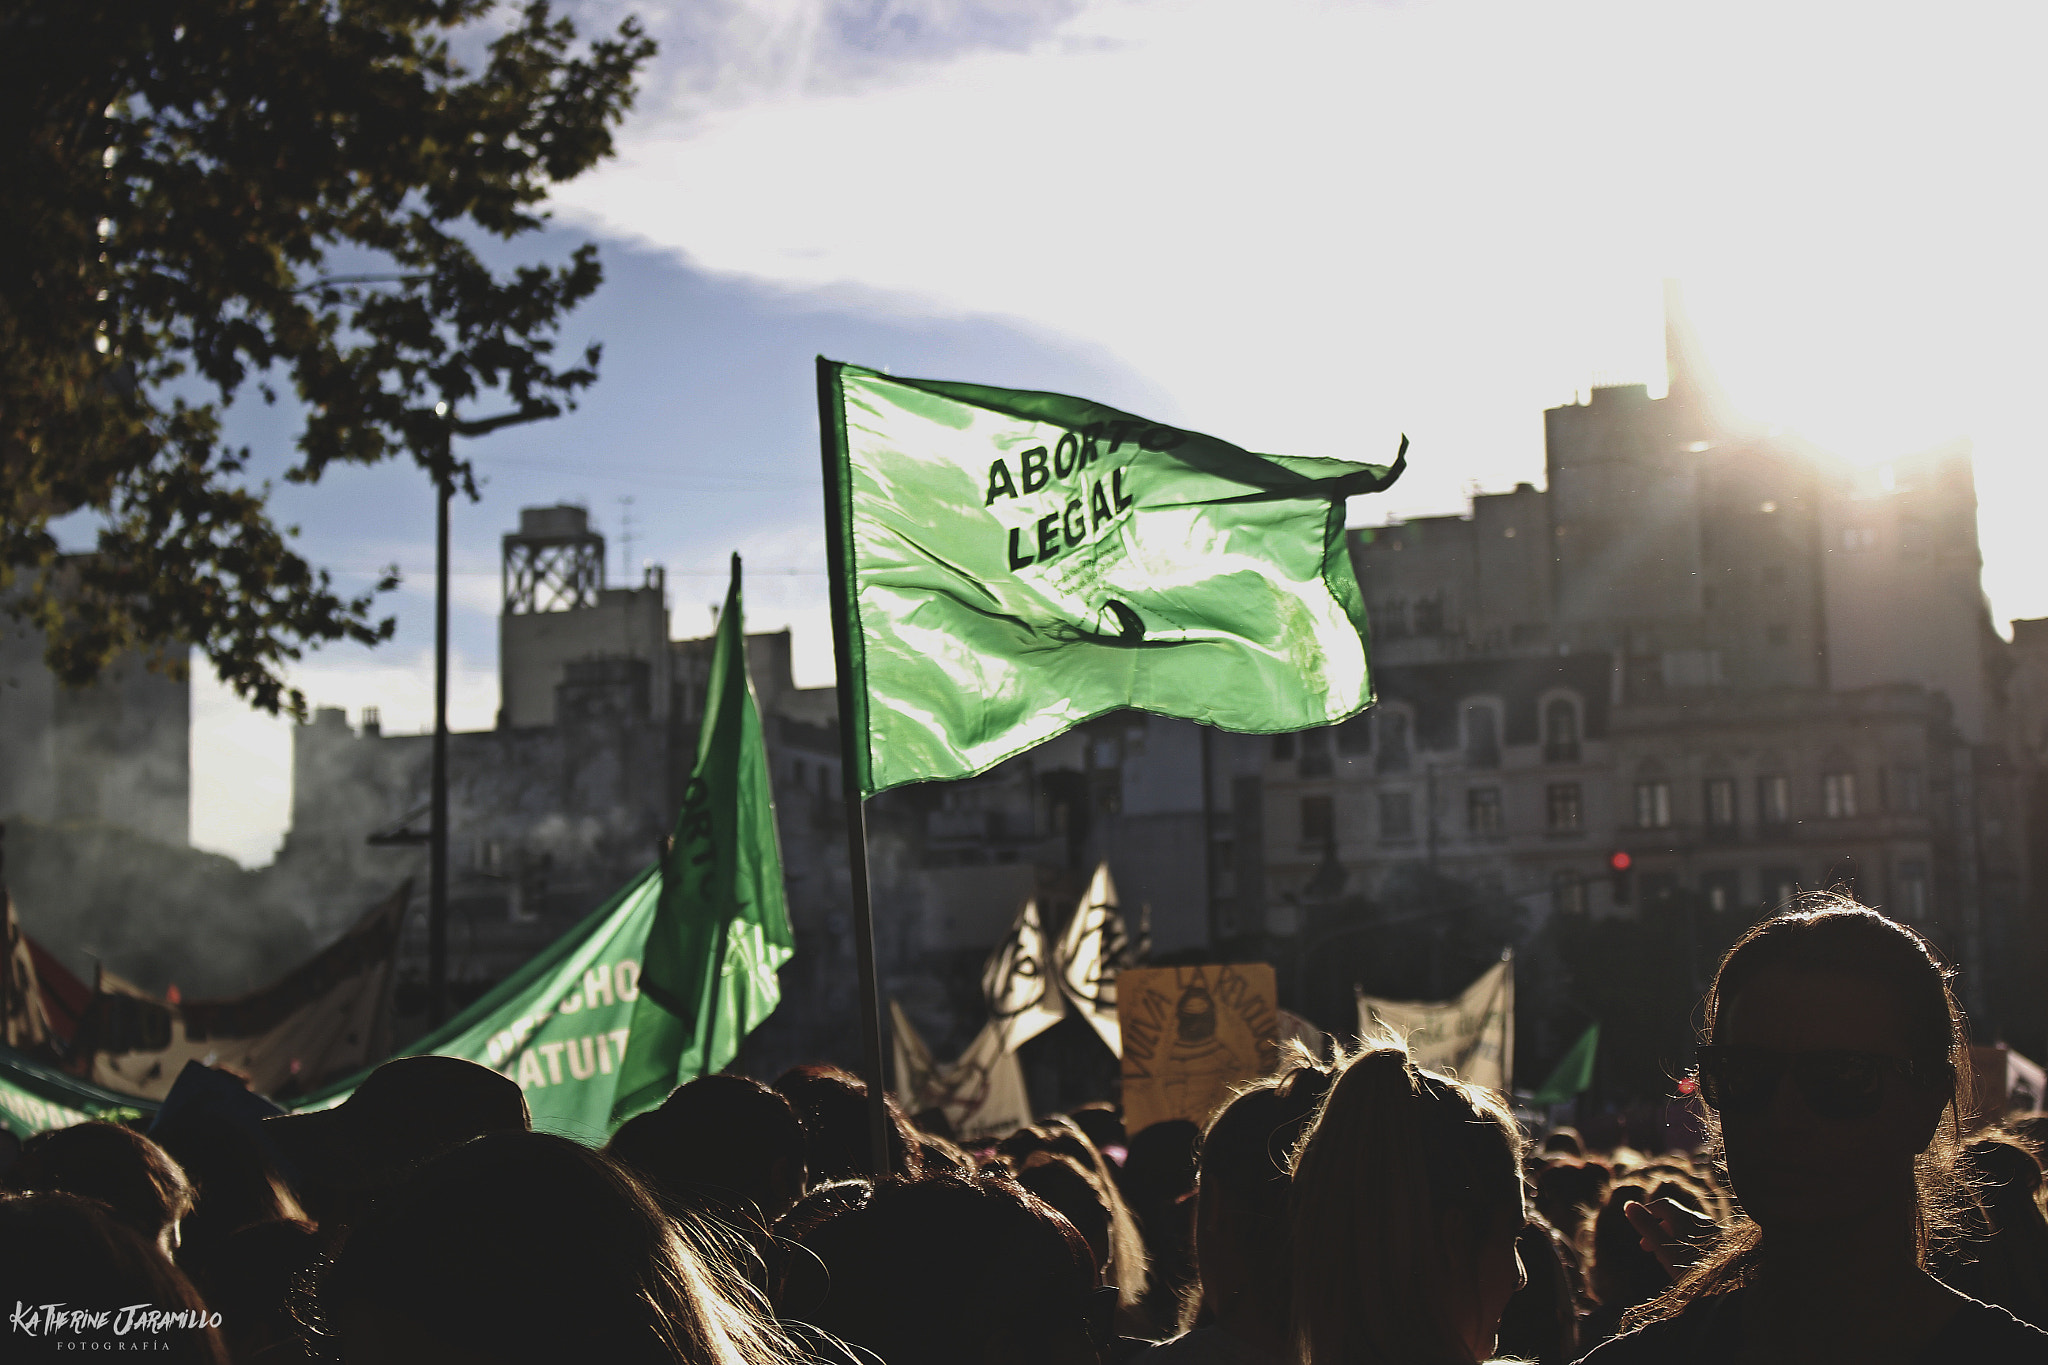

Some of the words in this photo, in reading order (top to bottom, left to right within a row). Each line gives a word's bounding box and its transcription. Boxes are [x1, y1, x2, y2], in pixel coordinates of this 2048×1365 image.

[985, 421, 1188, 506] ABORTO
[1008, 466, 1133, 572] LEGAL
[505, 1028, 630, 1090] ATUIT
